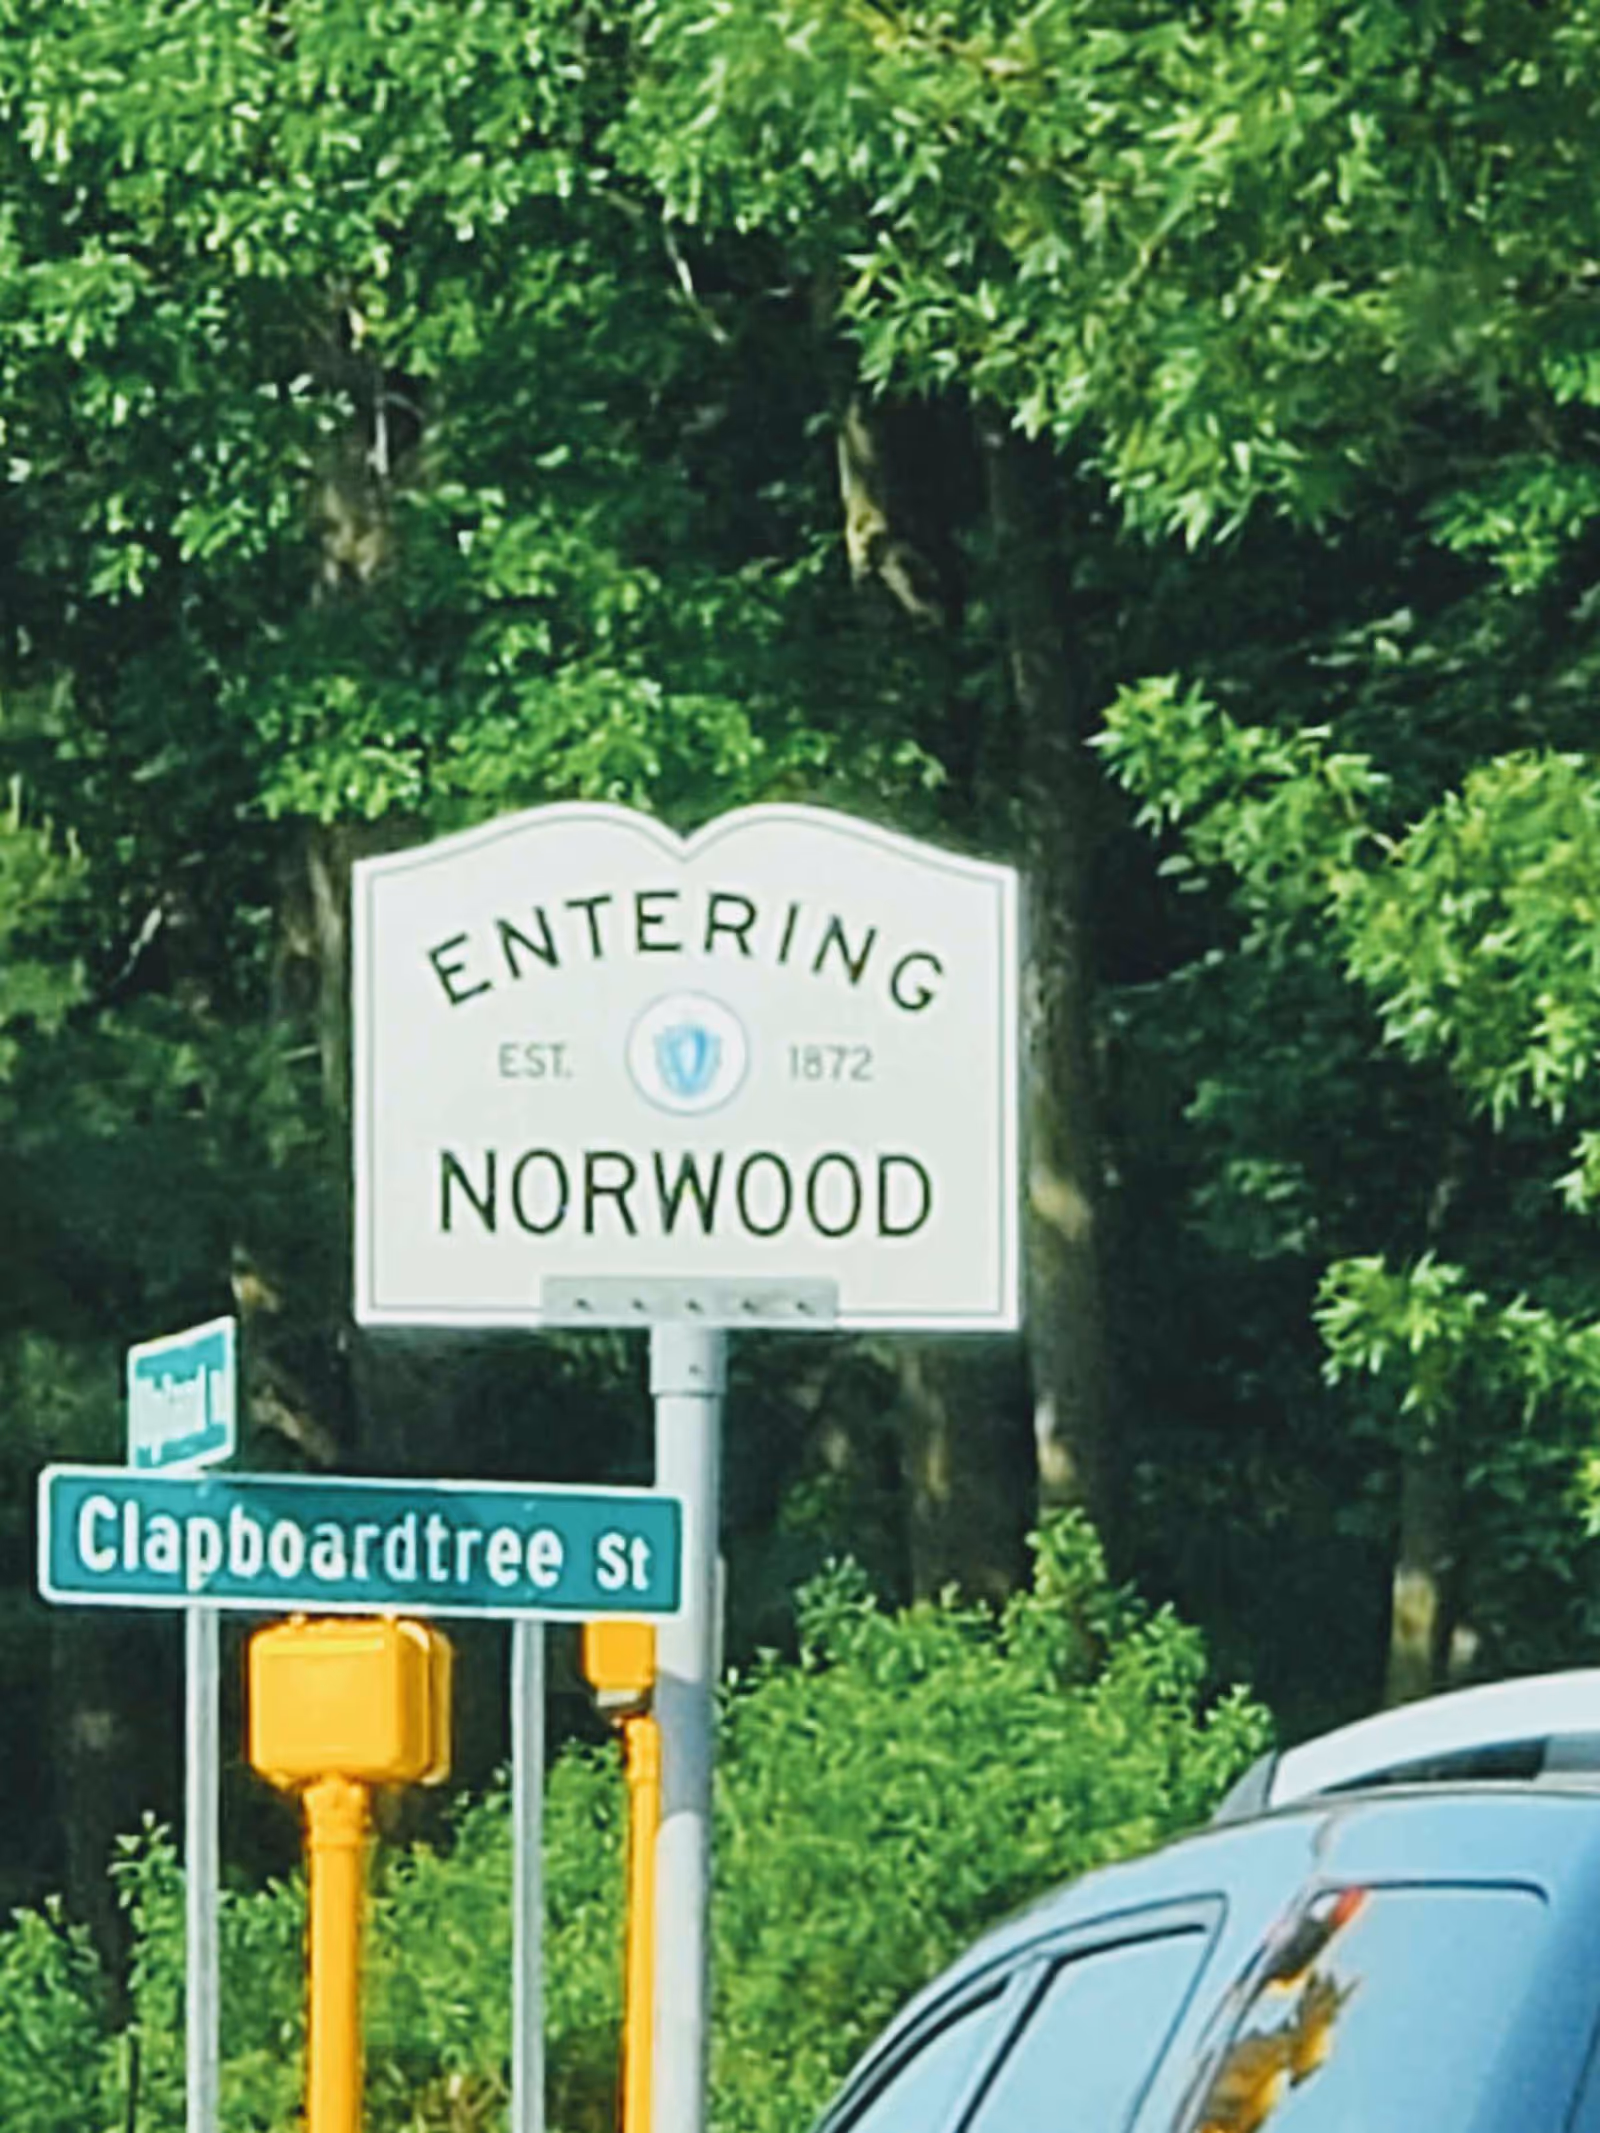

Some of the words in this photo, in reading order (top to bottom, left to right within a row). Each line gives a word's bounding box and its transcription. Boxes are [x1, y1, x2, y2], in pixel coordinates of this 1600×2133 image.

[427, 889, 944, 1012] ENTERING
[499, 1043, 573, 1080] EST.
[788, 1044, 874, 1082] 1872
[439, 1149, 933, 1238] NORWOOD
[77, 1494, 564, 1592] Clapboardtree
[596, 1531, 651, 1591] St
